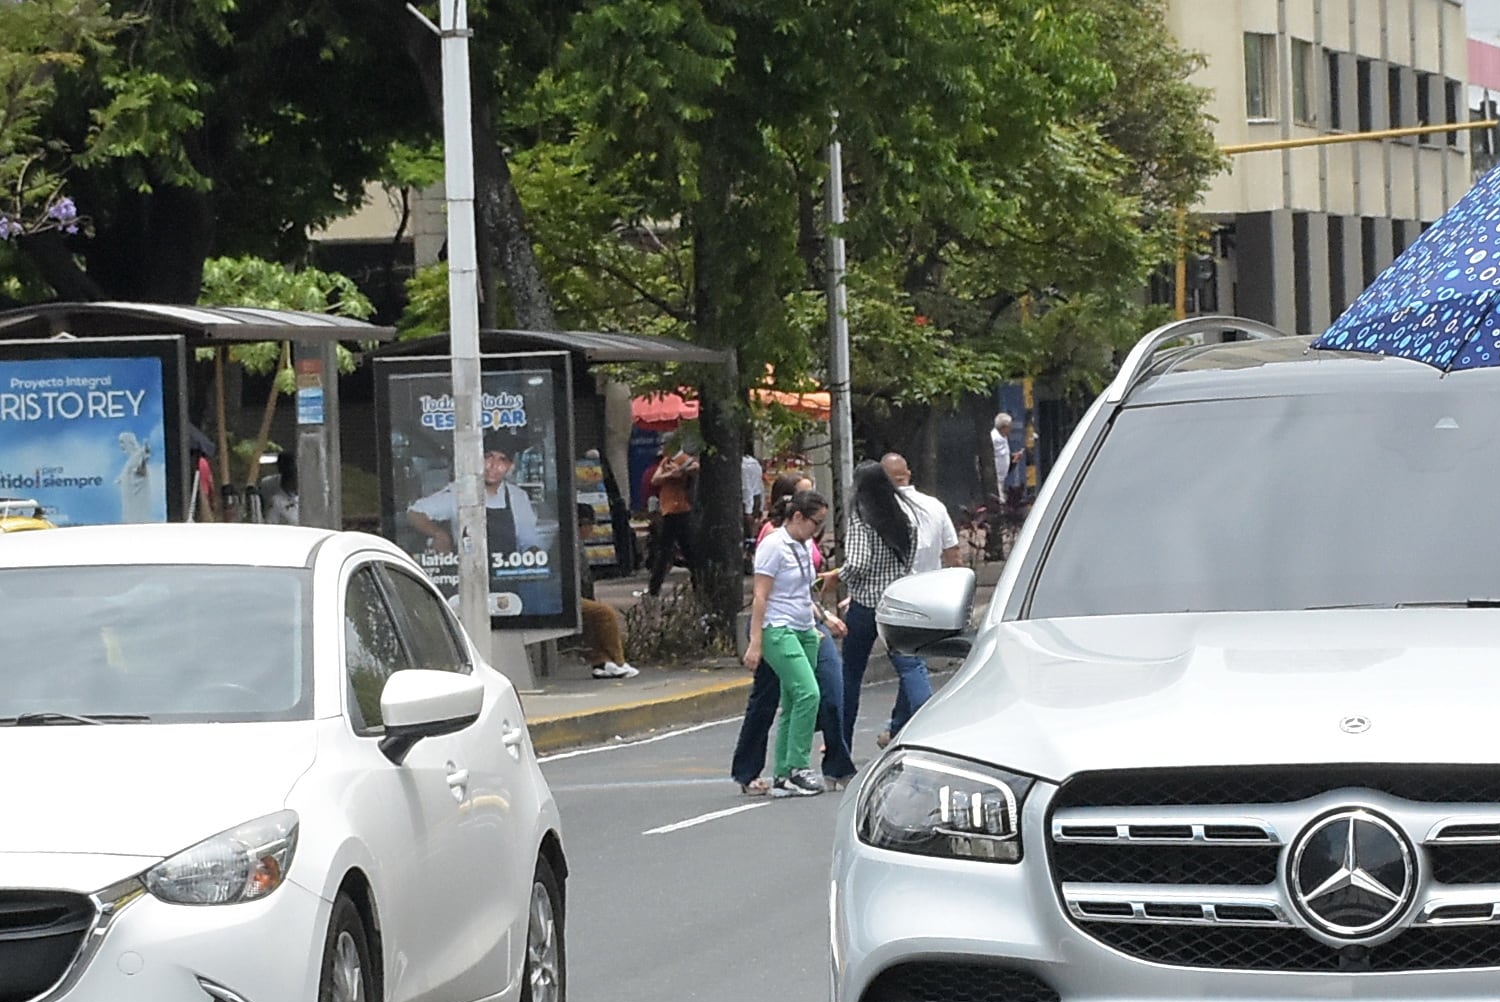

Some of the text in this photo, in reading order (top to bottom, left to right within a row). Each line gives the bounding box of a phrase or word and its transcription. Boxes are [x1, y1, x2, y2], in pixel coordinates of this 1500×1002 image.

[10, 375, 112, 389] Proyecto Integral
[88, 390, 145, 418] REY
[43, 473, 103, 489] siempre
[491, 550, 548, 568] 3.000
